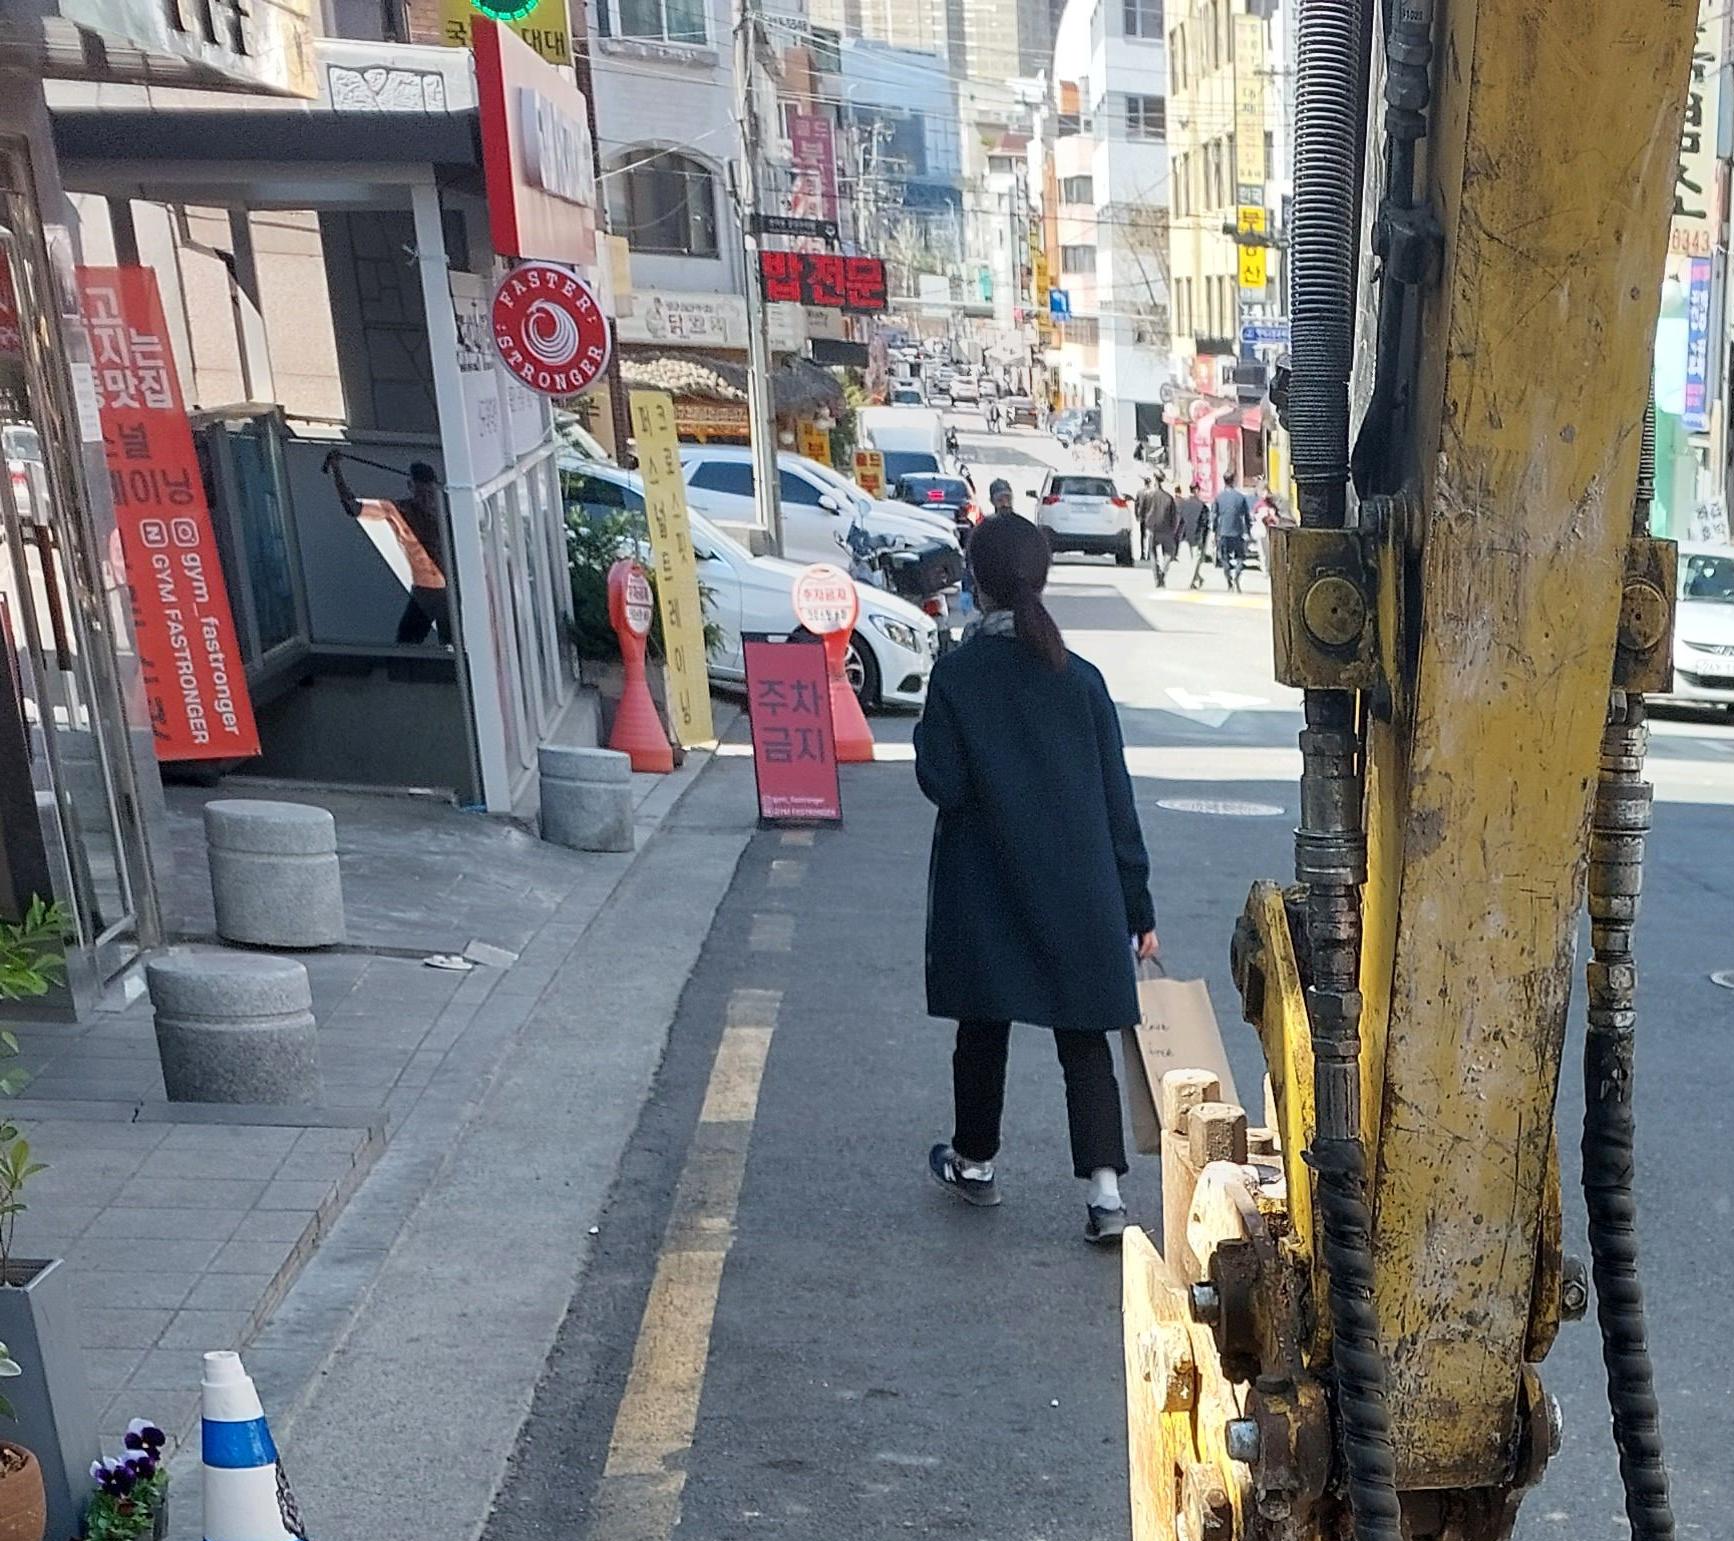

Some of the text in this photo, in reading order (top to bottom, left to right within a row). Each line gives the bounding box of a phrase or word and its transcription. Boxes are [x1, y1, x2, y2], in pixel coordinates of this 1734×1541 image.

[499, 271, 592, 314] FASTER
[497, 335, 604, 391] STRONGER
[152, 553, 179, 603] GYM
[164, 608, 210, 745] FASTRONGER
[758, 679, 824, 718] 주차
[762, 726, 826, 765] 금지
